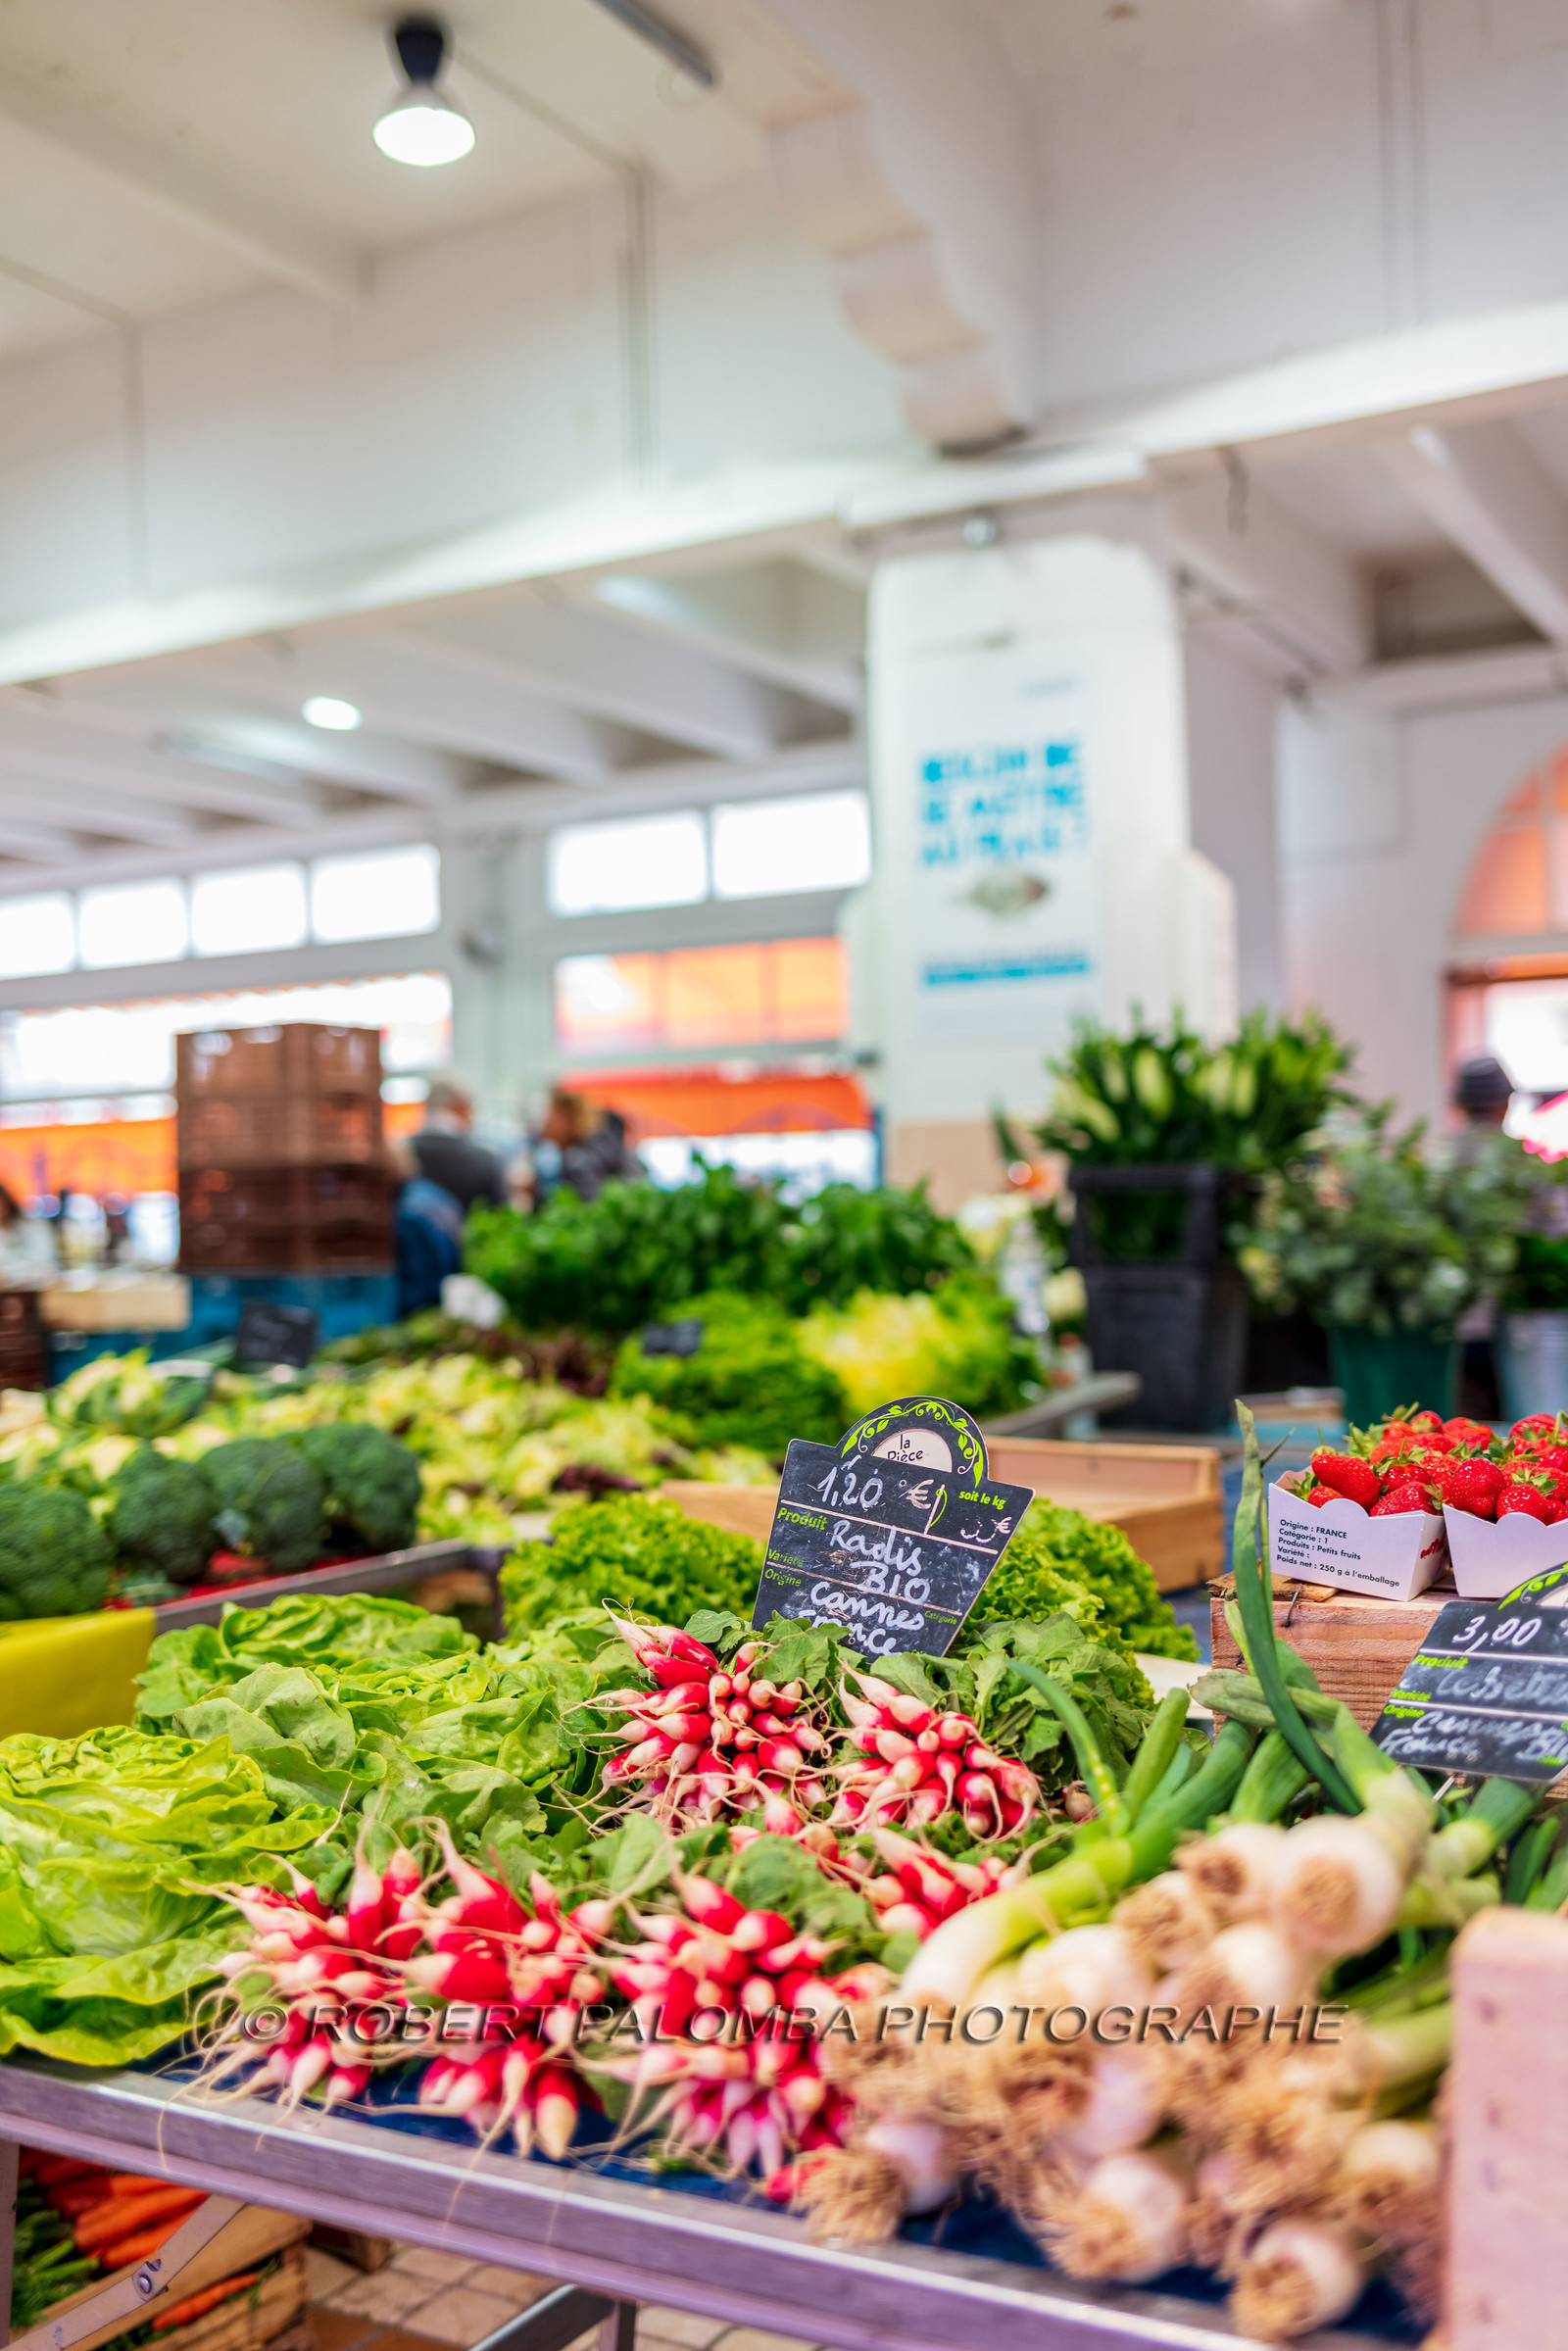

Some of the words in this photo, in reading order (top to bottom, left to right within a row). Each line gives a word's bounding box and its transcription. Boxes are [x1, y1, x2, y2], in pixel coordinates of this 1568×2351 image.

[900, 1434, 910, 1450] la
[817, 1466, 884, 1509] 1,20
[958, 1491, 980, 1502] soit
[980, 1493, 991, 1504] le
[992, 1494, 1006, 1510] kg
[776, 1507, 828, 1531] Produit
[1279, 1518, 1309, 1532] Origine
[1315, 1526, 1348, 1539] FRANCE
[1279, 1528, 1316, 1543] Catégorie
[829, 1519, 922, 1577] Radis
[1277, 1545, 1305, 1557] Variété
[1278, 1537, 1310, 1550] Produits
[1316, 1545, 1339, 1556] Petits
[1340, 1549, 1361, 1560] fruits
[1276, 1554, 1298, 1565] Poids
[1319, 1563, 1336, 1573] 250
[764, 1568, 802, 1587] Origine
[850, 1561, 930, 1603] BIO
[810, 1581, 924, 1631] Cannes
[1451, 1615, 1543, 1653] 3,00
[1412, 1654, 1469, 1670] Produit
[1384, 1704, 1425, 1719] Origine
